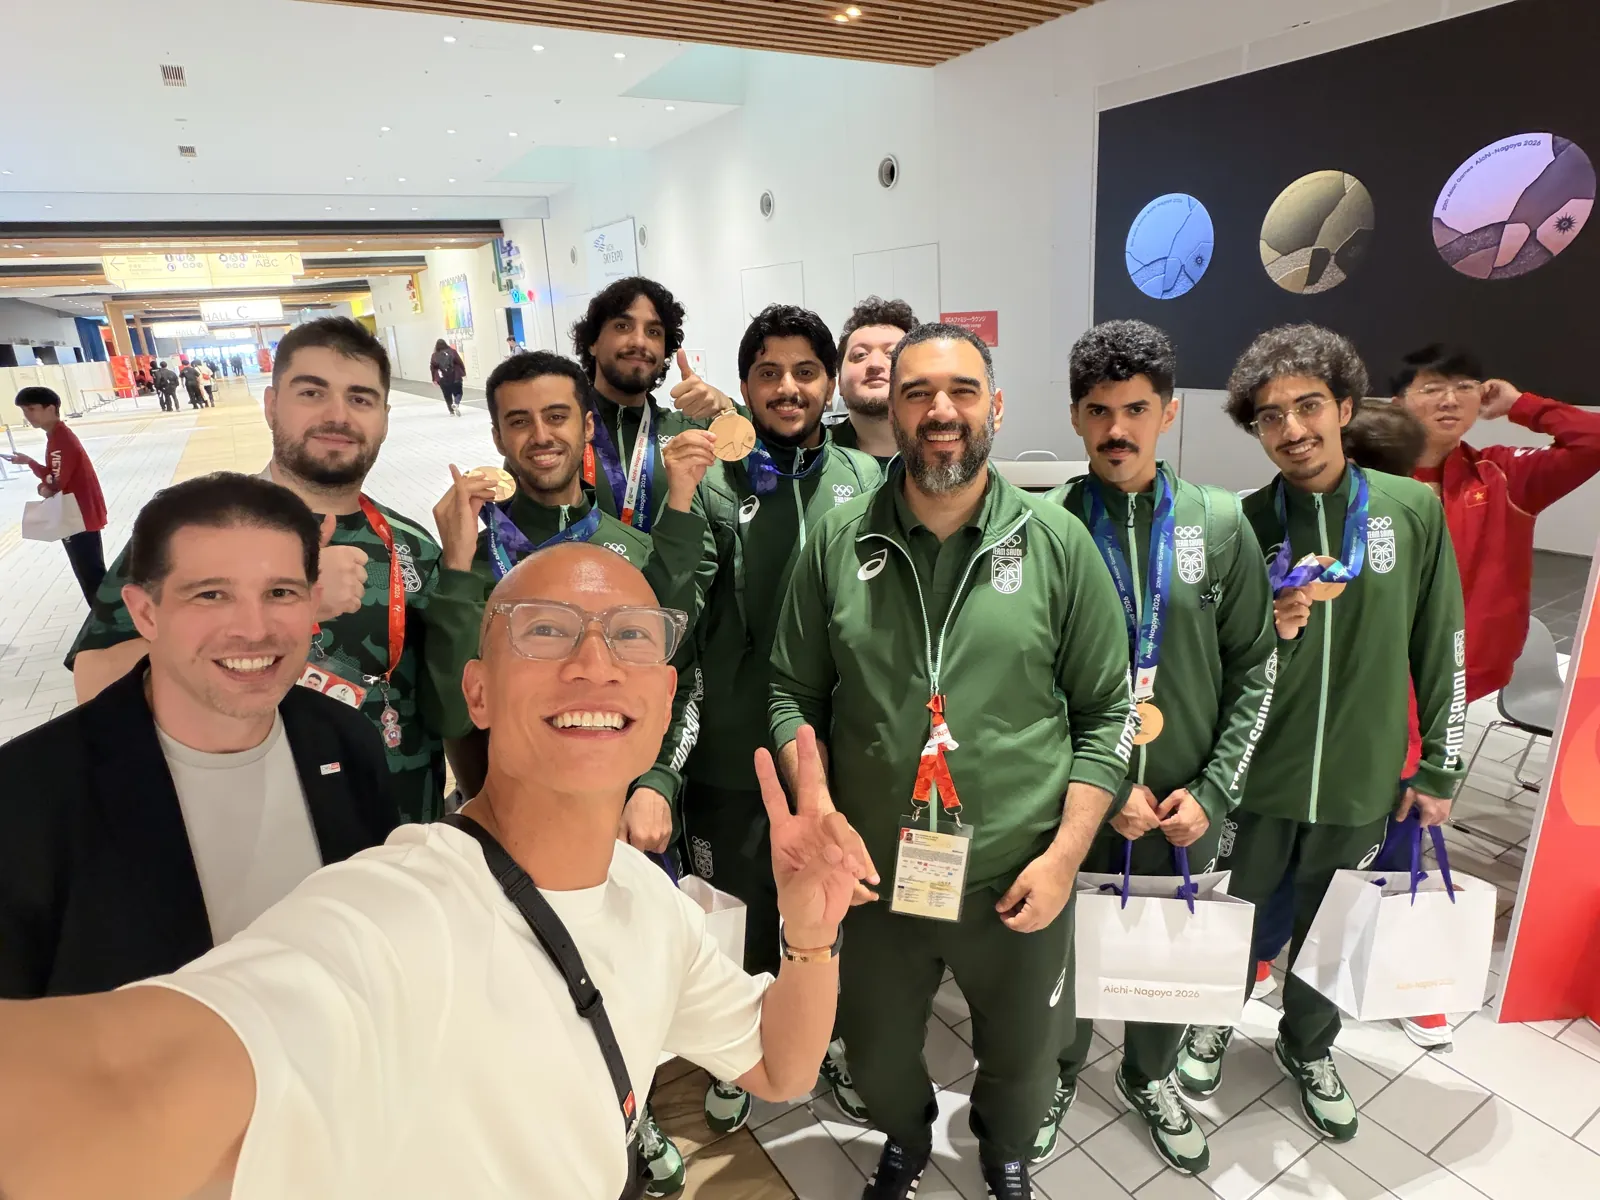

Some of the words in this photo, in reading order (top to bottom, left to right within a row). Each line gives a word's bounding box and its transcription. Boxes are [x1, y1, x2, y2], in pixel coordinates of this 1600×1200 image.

[1447, 182, 1458, 198] Asian
[1456, 165, 1474, 183] Games
[1475, 141, 1522, 166] Aichi-Nagoya
[1522, 139, 1542, 147] 2026
[255, 258, 280, 268] ABC
[202, 311, 232, 322] HALL
[236, 305, 250, 319] C
[631, 448, 643, 483] Aichi-Nagoya
[639, 489, 648, 528] Aichi-Nagoya
[1123, 595, 1133, 613] 2026
[1152, 593, 1161, 612] 2026
[1145, 612, 1160, 660] Aichi-Nagoya
[1447, 671, 1467, 725] SAUDI
[1443, 724, 1460, 773] TEAM
[1103, 984, 1173, 998] Aichi-Nagoya
[1174, 989, 1200, 998] 2026
